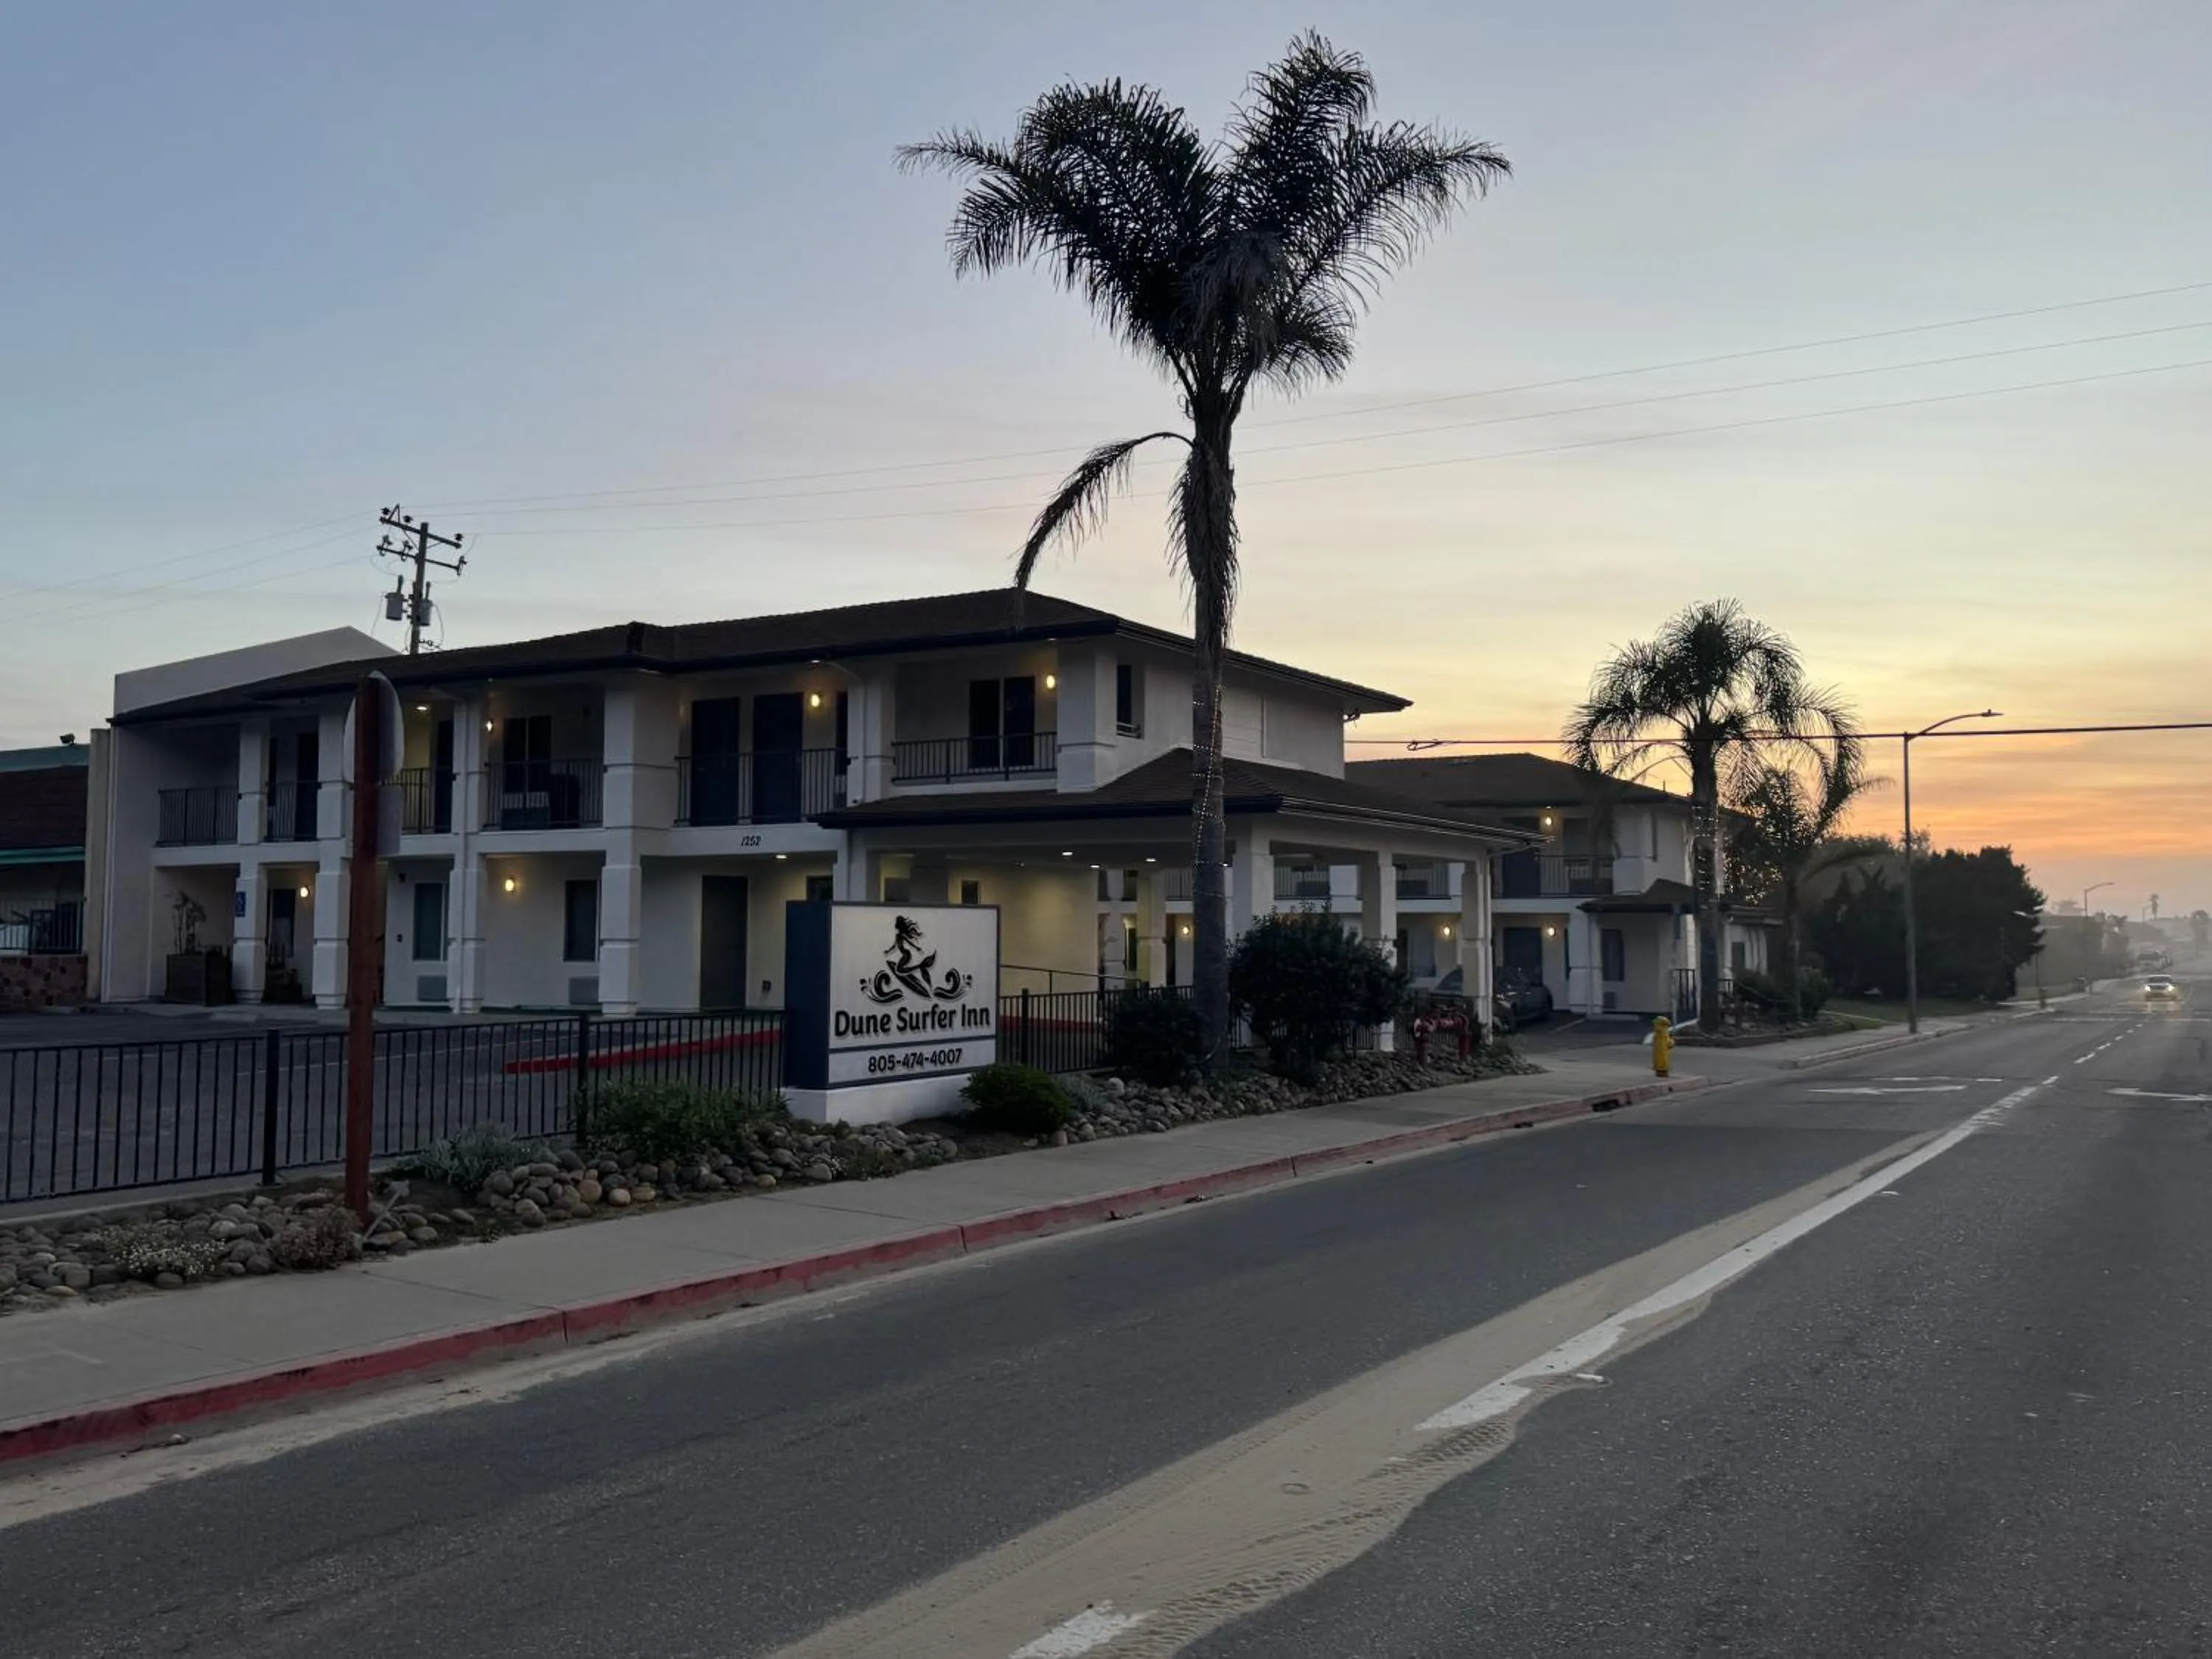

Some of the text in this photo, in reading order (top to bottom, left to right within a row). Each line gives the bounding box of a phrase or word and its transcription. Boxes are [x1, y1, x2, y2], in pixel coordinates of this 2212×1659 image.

[835, 1004, 990, 1037] Dune Surfer Inn
[868, 1048, 962, 1072] 805-474-4007
